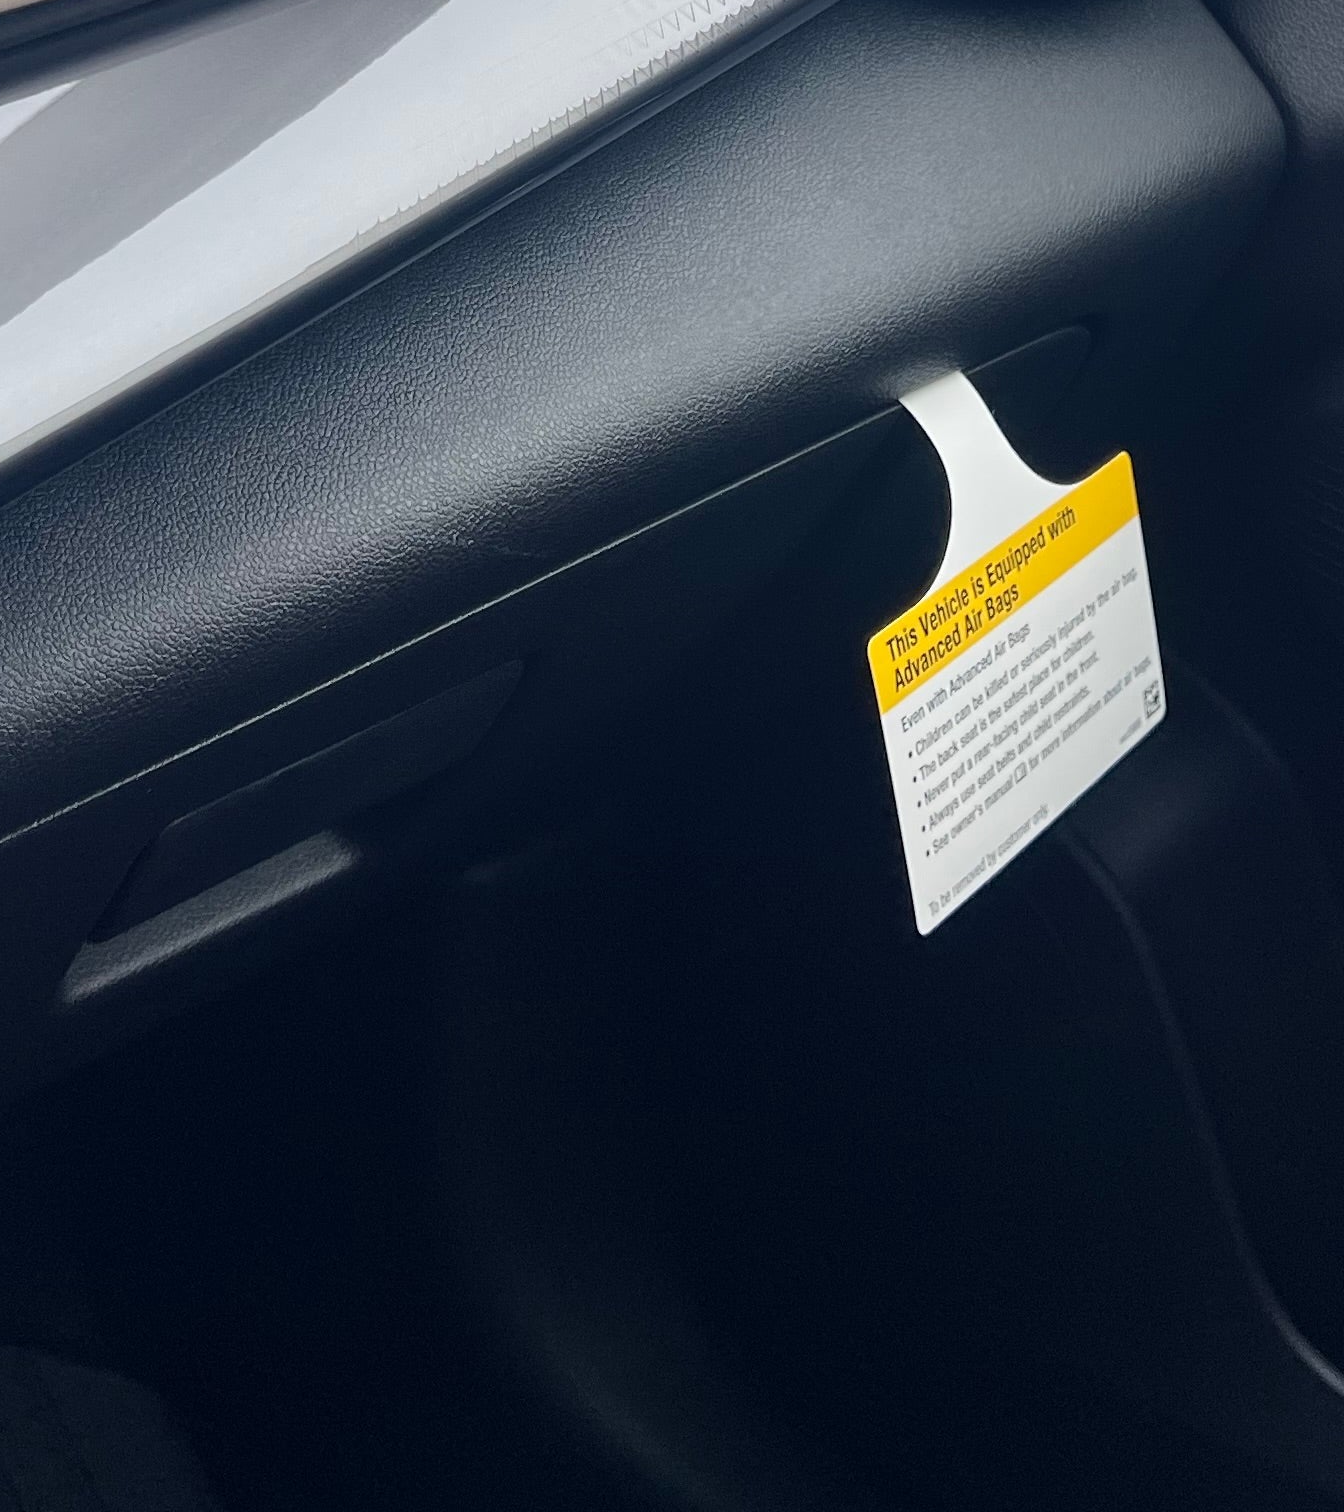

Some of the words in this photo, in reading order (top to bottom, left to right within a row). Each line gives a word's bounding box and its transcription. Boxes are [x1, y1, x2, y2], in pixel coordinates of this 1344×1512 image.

[885, 627, 917, 661] This
[918, 588, 969, 637] Vehicle
[969, 576, 984, 599] is
[985, 525, 1045, 587] Equipped
[1046, 505, 1076, 540] with
[894, 622, 961, 693] Advanced
[964, 608, 982, 638] Air
[984, 583, 1018, 621] Bags
[900, 705, 925, 733] Even
[925, 687, 947, 712] with
[949, 649, 992, 696] Advanced
[994, 640, 1006, 660] Air
[1007, 623, 1030, 648] Bags
[914, 718, 953, 756] Children
[954, 703, 971, 725] can
[971, 693, 983, 710] be
[984, 669, 1008, 700] killed
[1009, 663, 1018, 679] or
[1020, 632, 1056, 671] seriously
[1057, 607, 1085, 640] injured
[1085, 601, 1096, 617] by
[1096, 589, 1109, 607] the
[1110, 579, 1120, 596] air
[918, 759, 936, 780] The
[936, 740, 959, 766] back
[959, 723, 978, 748] seat
[978, 718, 987, 732] is
[987, 705, 1002, 724] the
[1003, 682, 1028, 712] safest
[1028, 666, 1049, 694] place
[1049, 655, 1061, 672] for
[923, 776, 949, 805] Never
[950, 761, 965, 787] put
[966, 757, 972, 770] a
[973, 719, 1018, 764] rear-facing
[1019, 699, 1038, 726] child
[1039, 685, 1057, 709] seat
[1056, 679, 1065, 693] in
[1065, 668, 1078, 685] the
[928, 796, 959, 831] Always
[959, 782, 976, 803] use
[977, 764, 995, 789] seat
[995, 748, 1016, 773] belts
[1016, 731, 1032, 755] and
[1033, 714, 1052, 741] child
[932, 832, 949, 854] See
[950, 803, 984, 839] owner's
[983, 774, 1013, 810] manual
[1027, 753, 1039, 771] for
[1040, 736, 1060, 760] more
[1060, 699, 1102, 742] information
[1102, 679, 1122, 705] about
[1123, 670, 1132, 686] air
[928, 900, 939, 916] To
[939, 890, 951, 907] be
